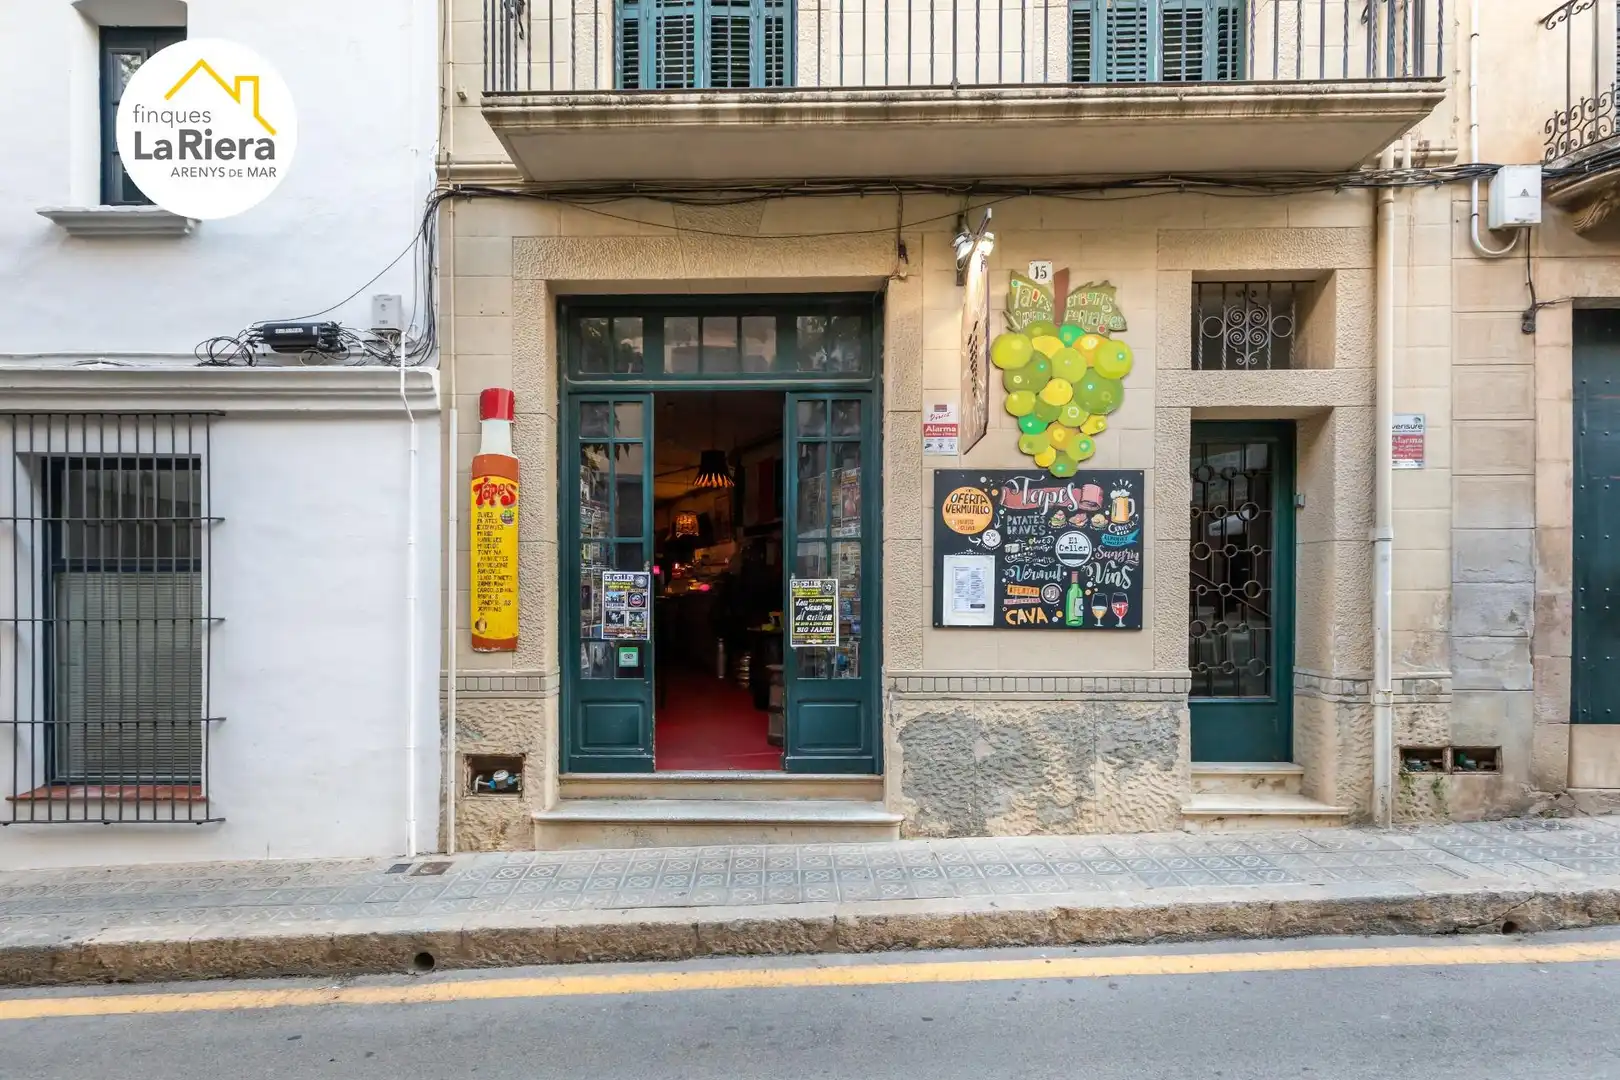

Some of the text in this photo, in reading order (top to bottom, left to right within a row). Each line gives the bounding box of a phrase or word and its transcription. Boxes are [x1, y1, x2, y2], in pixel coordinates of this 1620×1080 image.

[1034, 265, 1047, 280] 15
[925, 424, 957, 433] Alarma
[950, 492, 989, 505] OFERTA
[1004, 475, 1079, 516] Tapes
[1006, 514, 1046, 526] PATATES
[1006, 525, 1046, 536] BRAVES
[1059, 544, 1088, 552] Celler
[1095, 544, 1139, 563] Sangria
[1004, 563, 1063, 582] Vermut
[1085, 560, 1134, 590] Vins
[1005, 606, 1049, 626] CAVA
